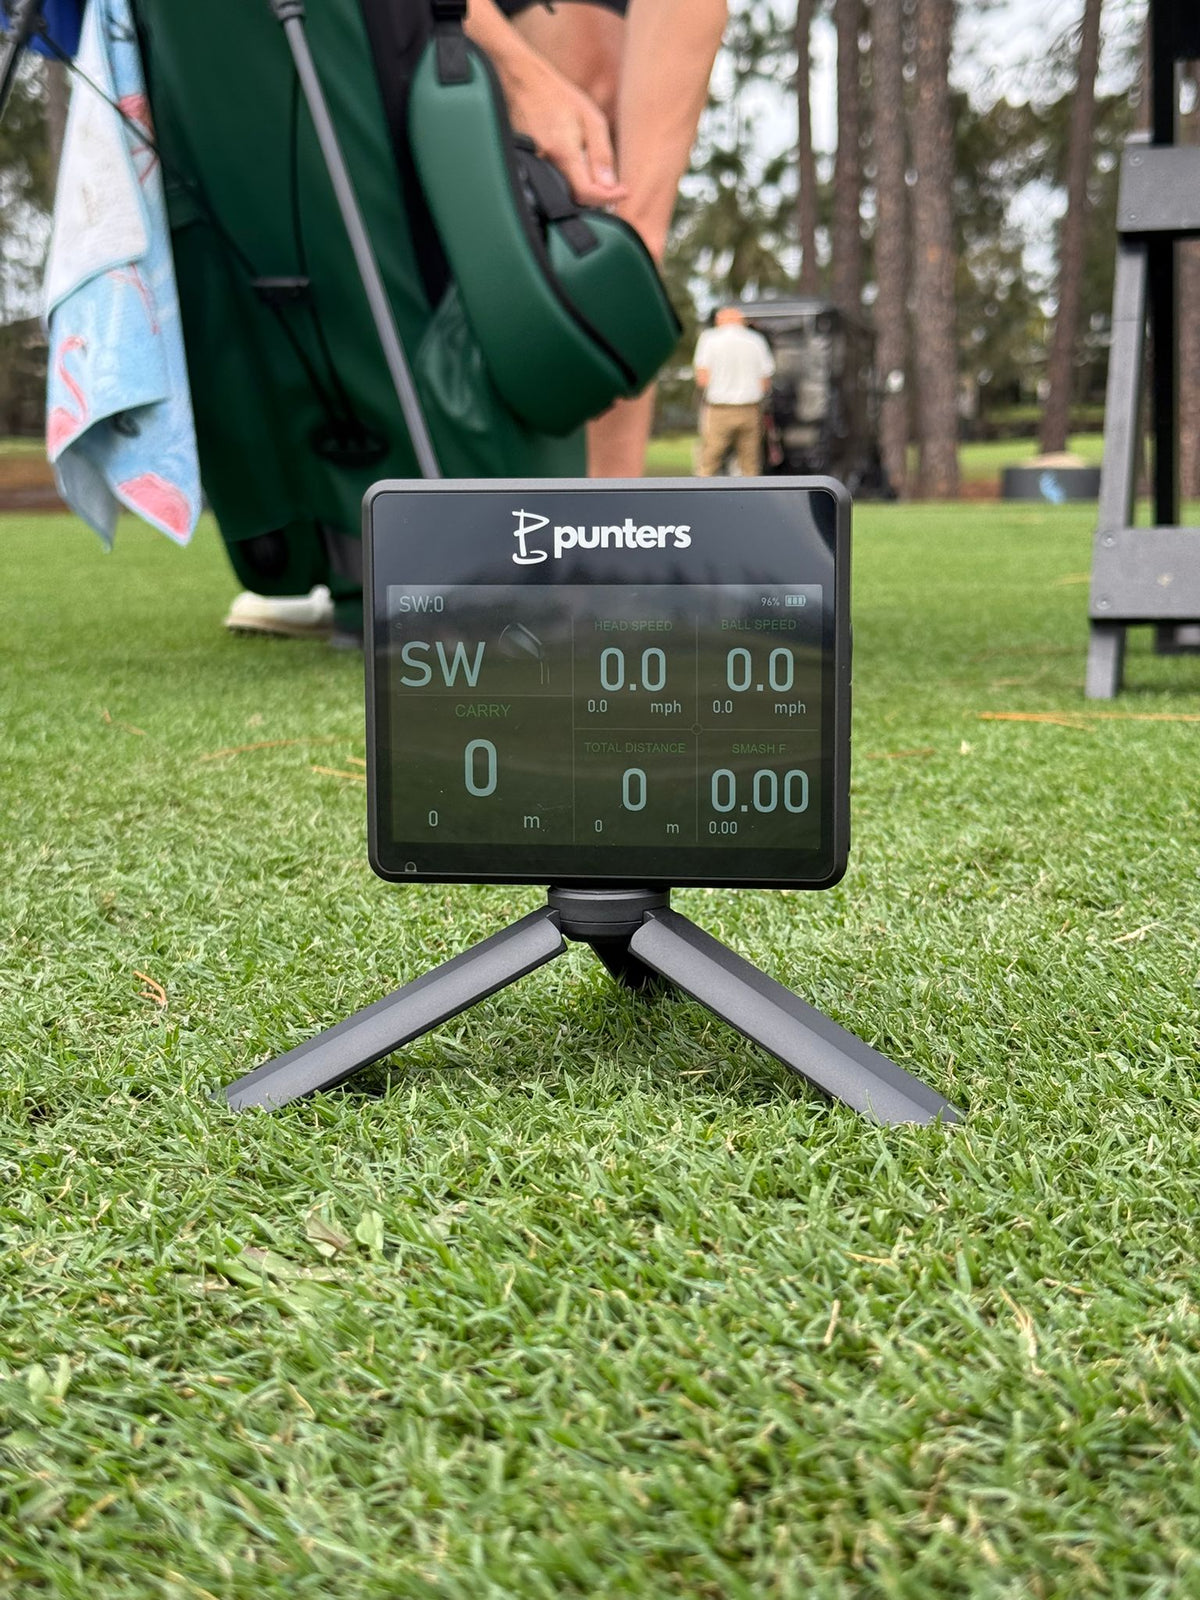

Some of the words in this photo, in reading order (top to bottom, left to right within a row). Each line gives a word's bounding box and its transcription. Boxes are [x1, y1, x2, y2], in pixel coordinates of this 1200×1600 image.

[553, 518, 692, 558] punters
[399, 595, 444, 613] SW:0
[761, 597, 780, 607] 96%
[594, 620, 629, 631] HEAD
[631, 620, 673, 631] SPEED
[720, 619, 752, 631] BALL
[754, 619, 796, 631] SPEED
[400, 641, 485, 687] SW
[600, 647, 666, 691] 0.0
[726, 647, 794, 691] 0.0
[455, 704, 511, 718] CARRY
[587, 700, 608, 713] 0.0
[650, 701, 682, 716] mph
[712, 700, 733, 713] 0.0
[774, 701, 806, 716] mph
[584, 742, 623, 754] TOTAL
[625, 742, 686, 754] DISTANCE
[731, 743, 774, 754] SMASH
[778, 744, 785, 754] F
[464, 738, 498, 797] 0
[622, 767, 647, 812] 0
[710, 768, 809, 814] 0.00
[428, 810, 438, 827] 0
[523, 815, 540, 827] m
[594, 819, 603, 832] 0
[666, 821, 680, 833] m
[708, 820, 738, 835] 0.00
